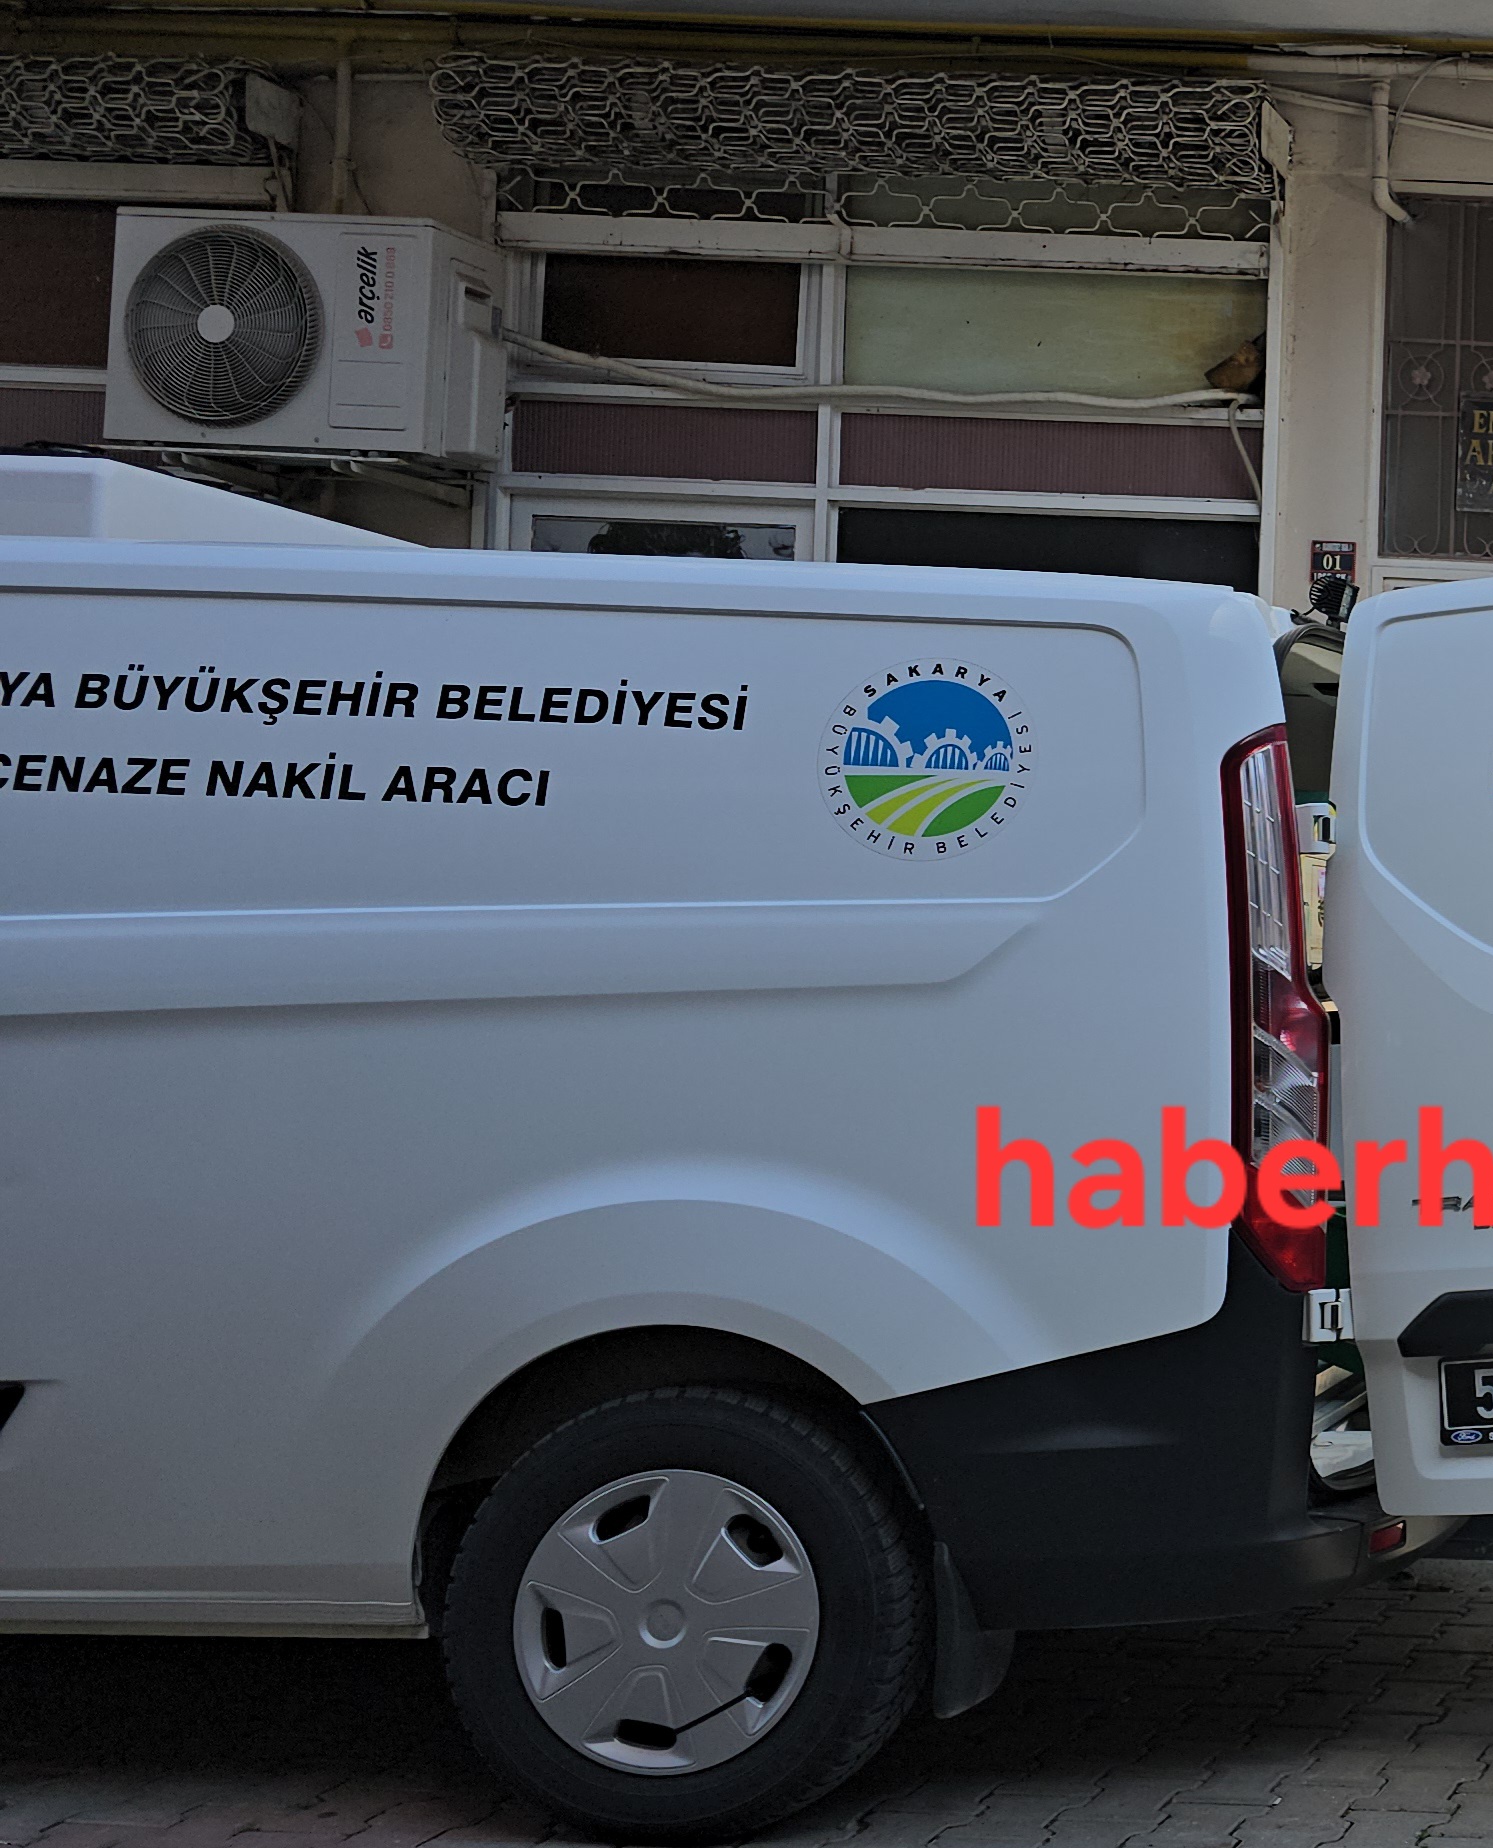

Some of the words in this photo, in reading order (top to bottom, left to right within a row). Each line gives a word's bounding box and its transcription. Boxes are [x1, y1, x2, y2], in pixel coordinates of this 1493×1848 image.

[357, 246, 380, 324] arçelik
[1323, 554, 1341, 570] 01
[0, 672, 55, 707] YA
[75, 664, 419, 725] BÜYÜKŞEHİR
[436, 679, 748, 731] BELEDİYESİ
[864, 664, 1008, 702] SAKARYA
[205, 752, 367, 801] NAKİL
[381, 767, 550, 806] ARACI
[825, 705, 915, 854] BÜYÜKŞEHİR
